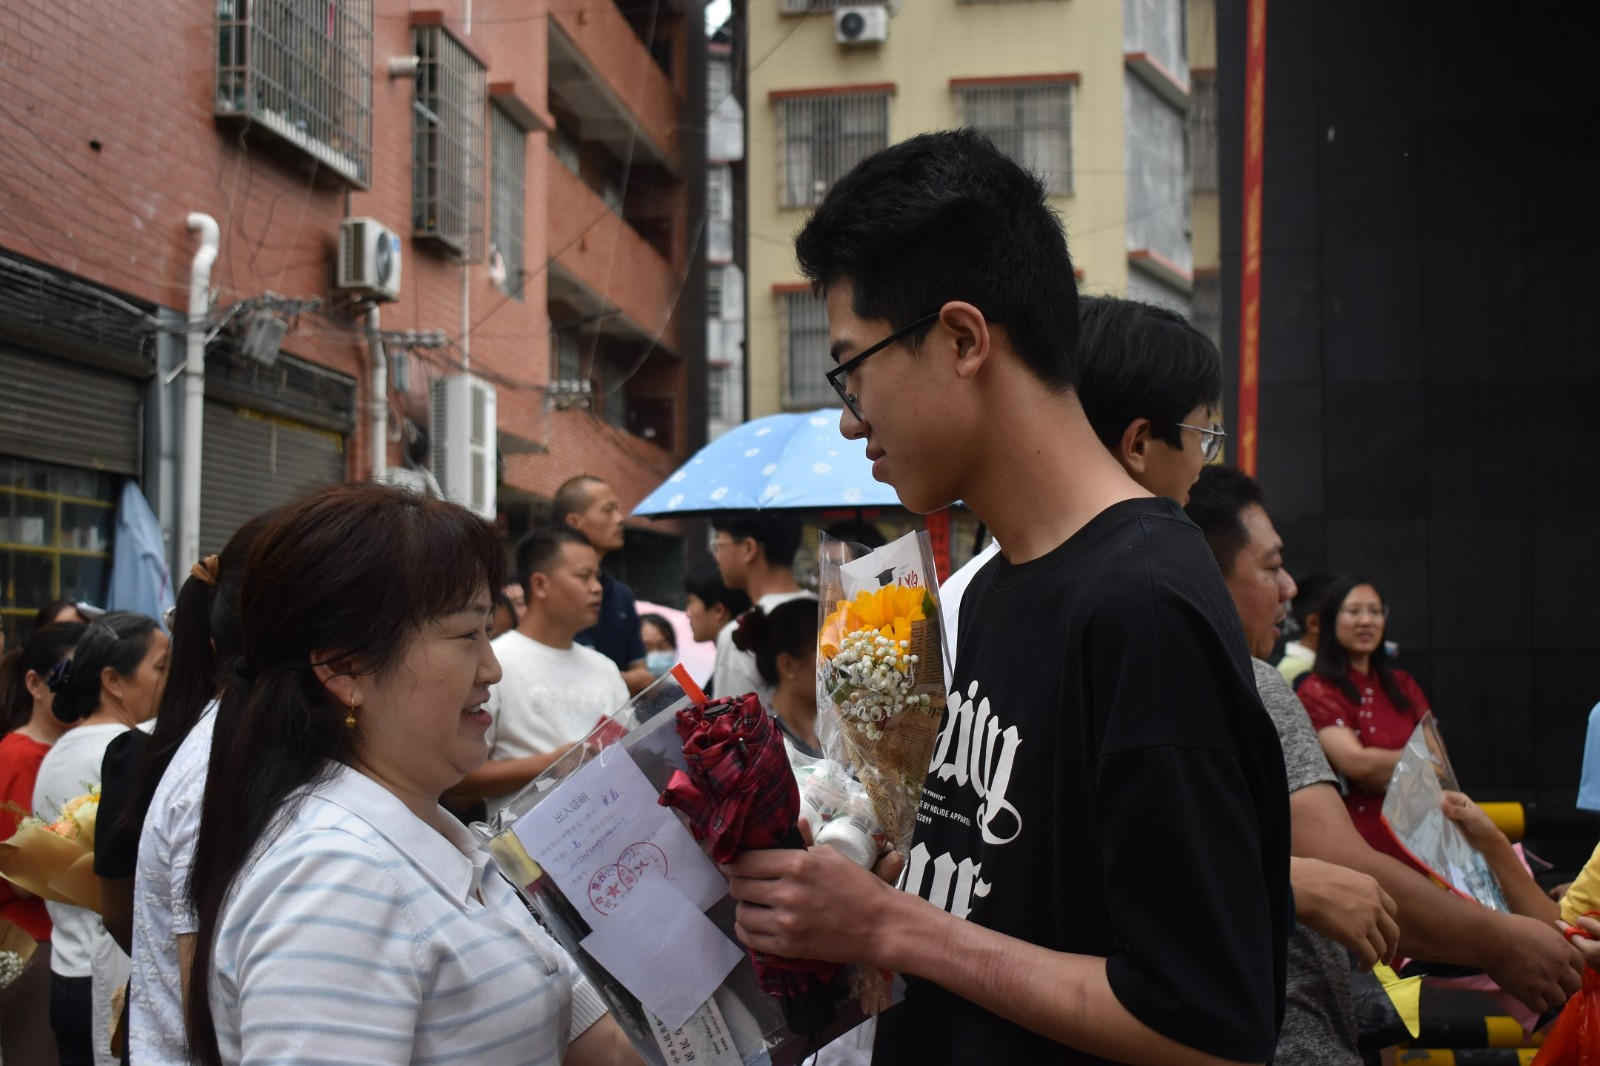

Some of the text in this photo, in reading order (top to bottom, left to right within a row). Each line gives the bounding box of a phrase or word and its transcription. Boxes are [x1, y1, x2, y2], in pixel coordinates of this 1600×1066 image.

[554, 792, 589, 824] 出入证明
[923, 802, 930, 810] BY
[950, 811, 971, 826] APPAREL
[652, 1012, 681, 1064] 中华人民共和
